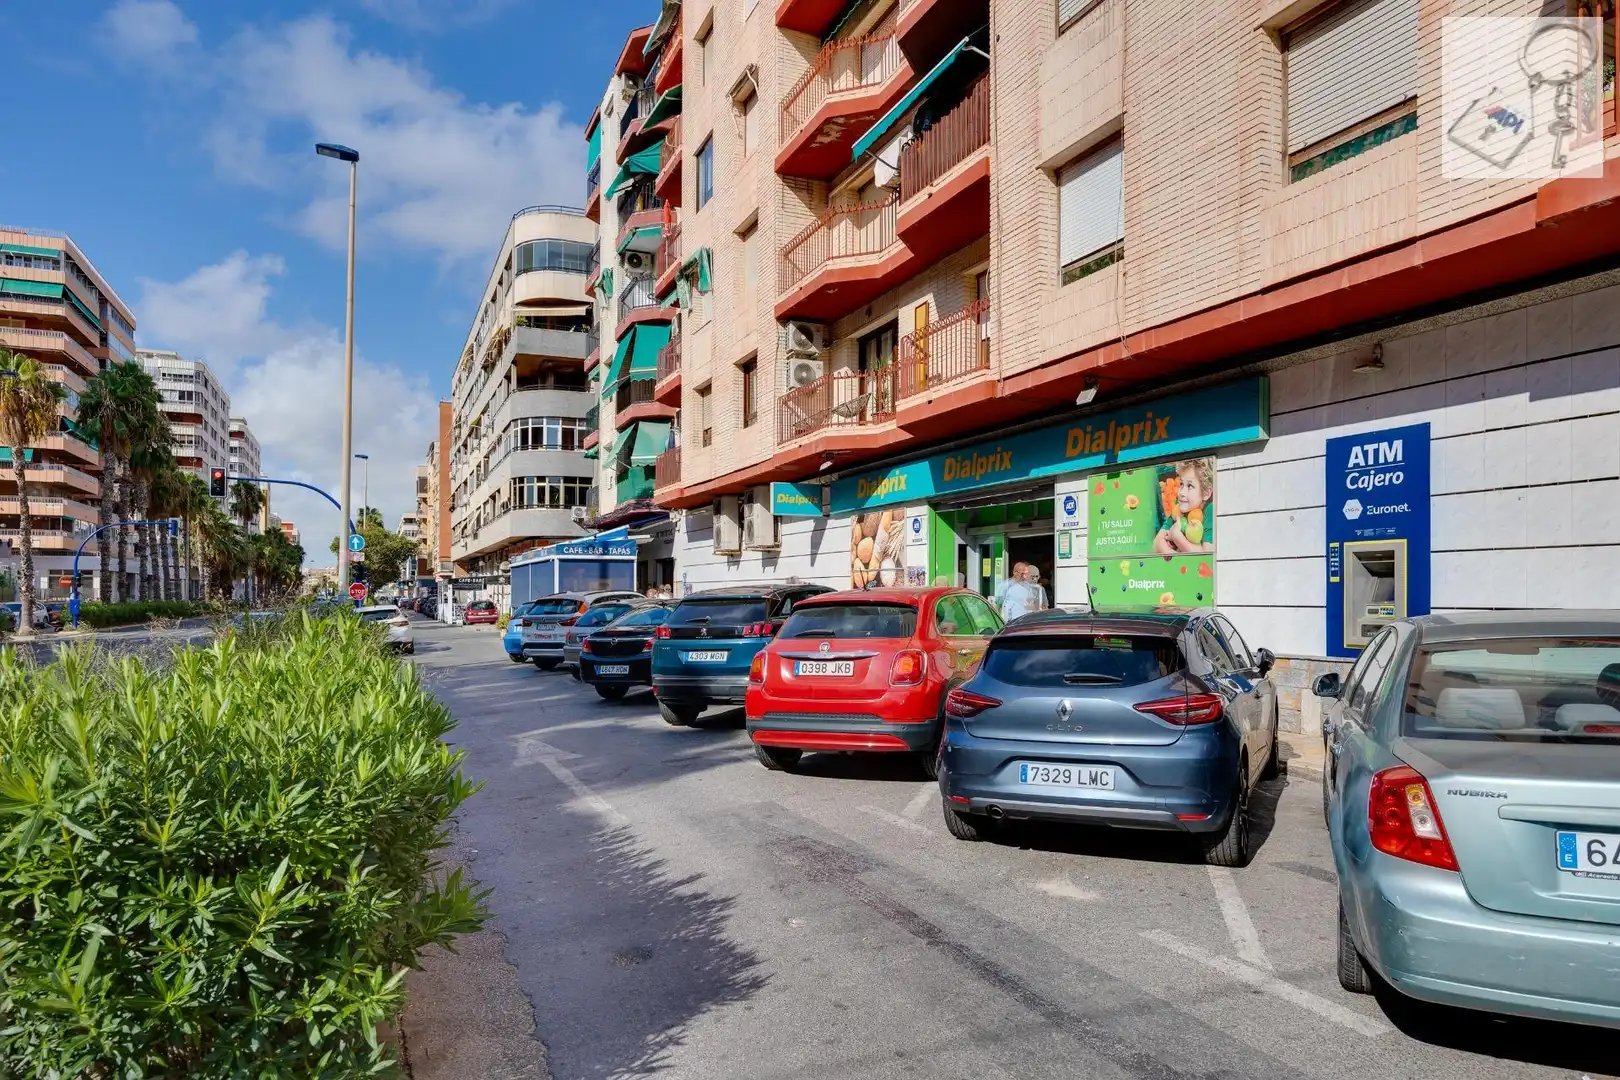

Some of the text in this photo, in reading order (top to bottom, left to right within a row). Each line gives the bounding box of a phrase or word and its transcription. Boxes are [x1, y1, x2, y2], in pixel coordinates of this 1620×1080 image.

[1065, 412, 1170, 458] Dialprix
[1347, 439, 1403, 468] ATM
[943, 447, 1013, 482] Dialprix
[857, 470, 907, 499] Dialprix
[1346, 470, 1404, 491] Cajero
[776, 492, 819, 505] Dialprix
[1111, 519, 1133, 528] SALUD
[1096, 536, 1116, 546] JUSTO
[608, 547, 631, 555] TAPAS
[1128, 579, 1165, 592] Dialprix
[689, 652, 726, 661] 4303 MGN
[801, 663, 851, 673] 0398 JKB
[1030, 766, 1110, 787] 7329 LMC
[1447, 789, 1508, 799] NUBIRA
[1564, 854, 1573, 862] E
